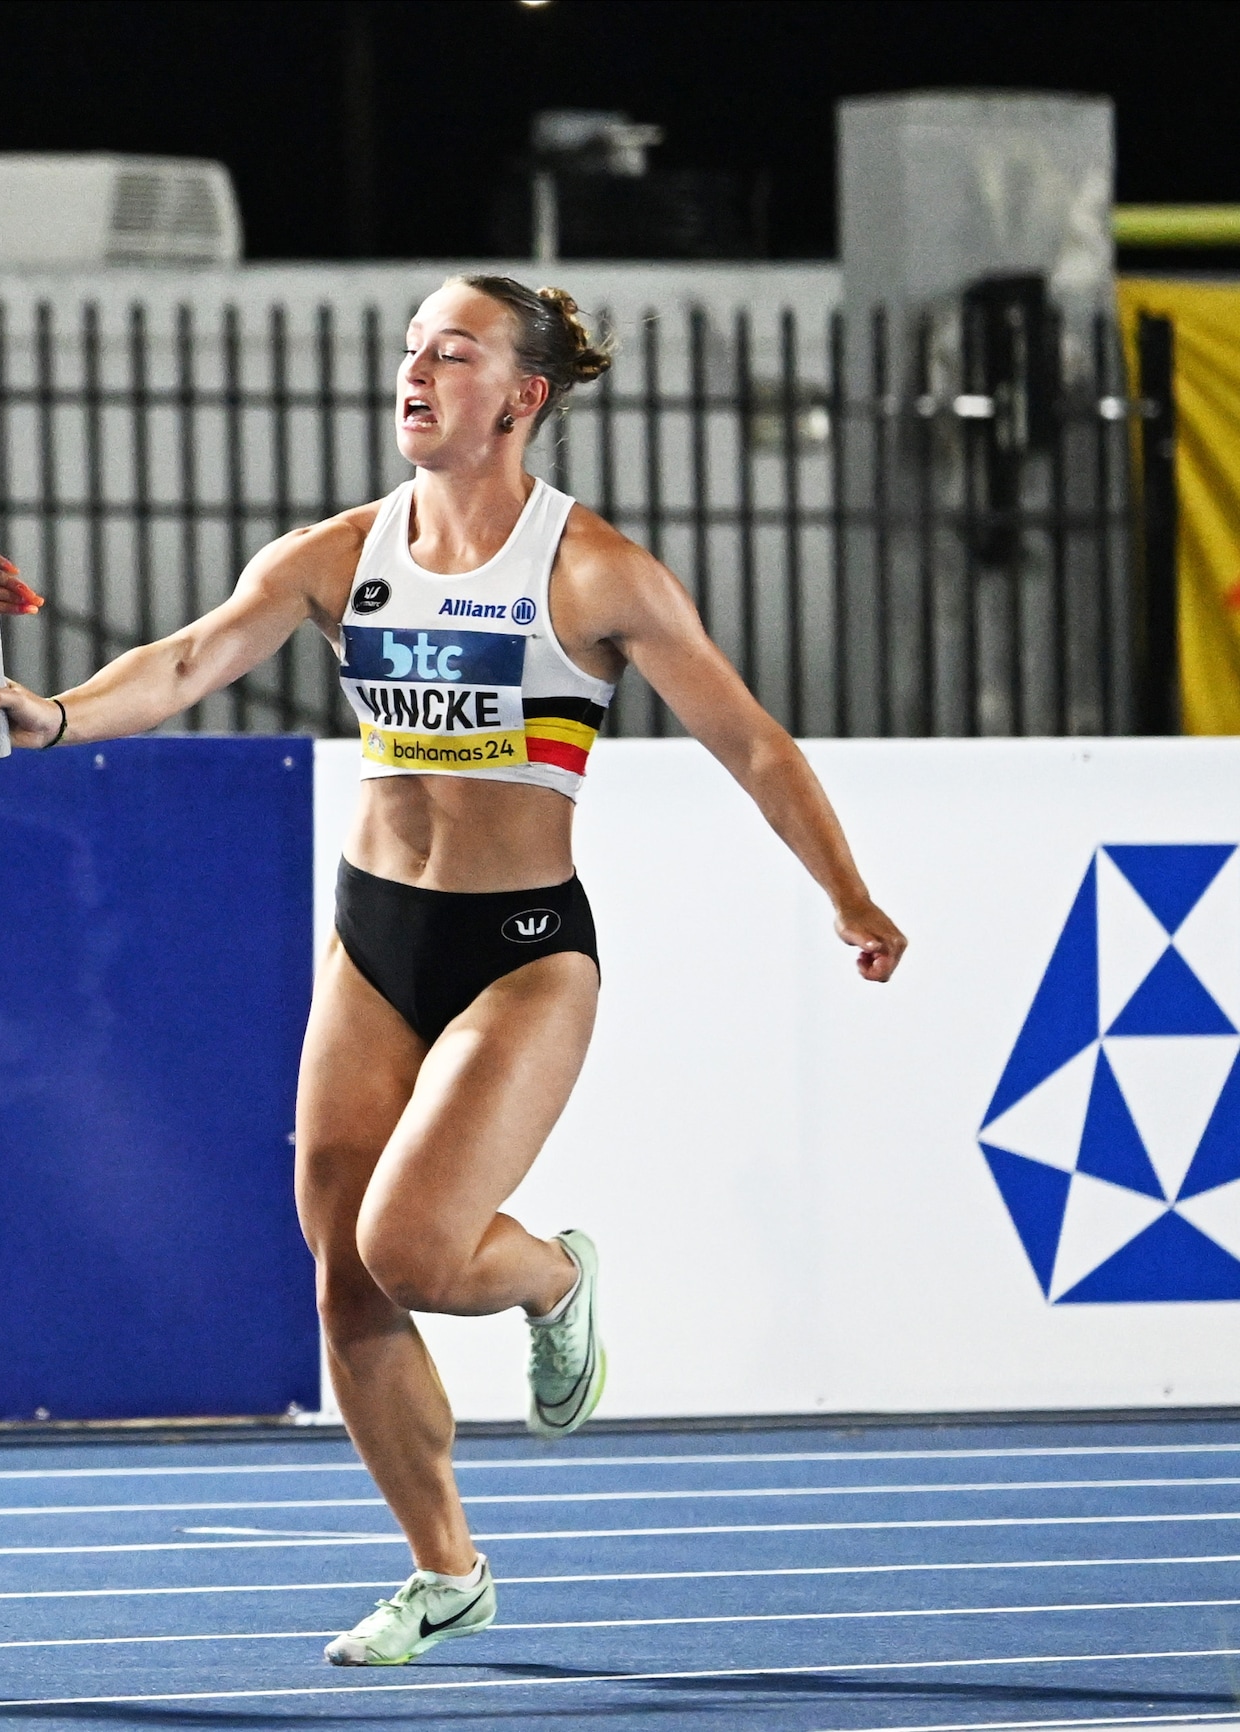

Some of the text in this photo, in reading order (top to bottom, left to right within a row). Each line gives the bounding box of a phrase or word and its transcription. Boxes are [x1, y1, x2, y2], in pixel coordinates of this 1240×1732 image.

[438, 598, 507, 619] Allianz
[382, 631, 463, 681] btc
[356, 686, 502, 731] VINCKE
